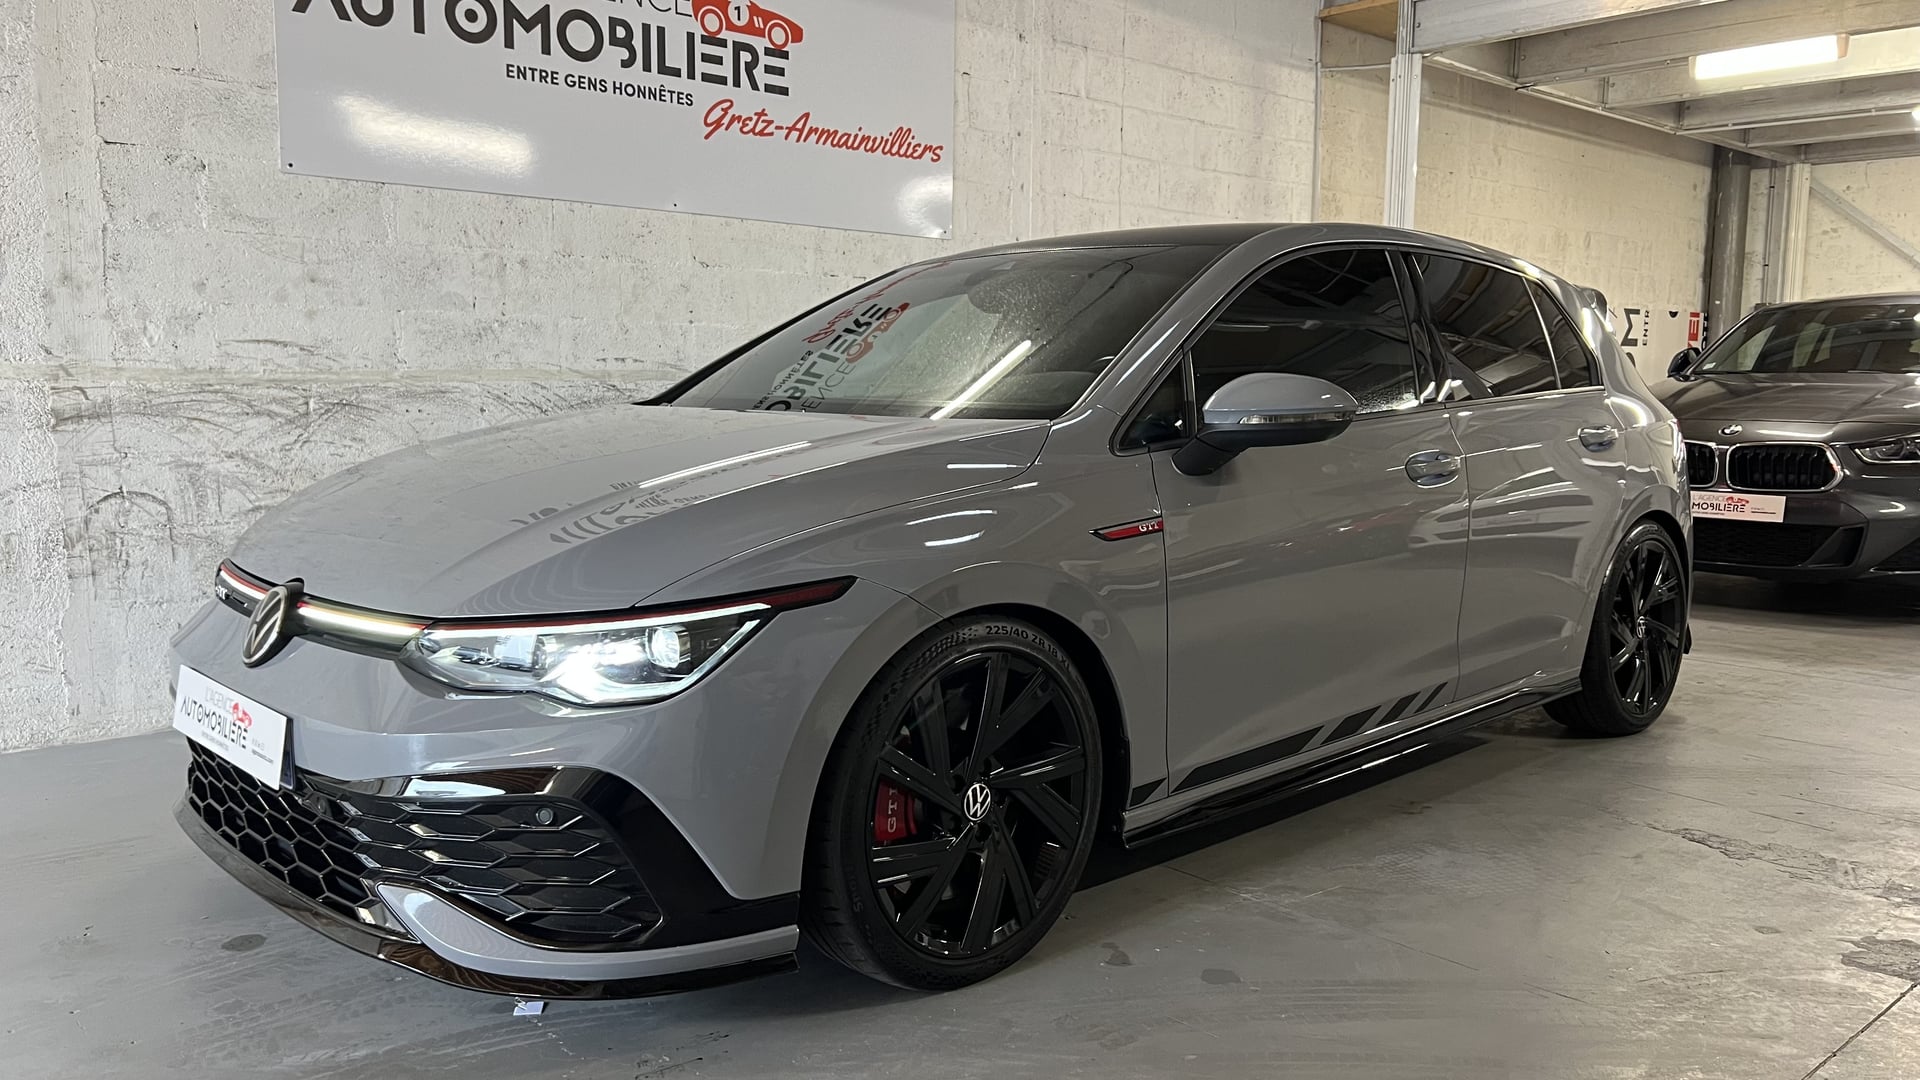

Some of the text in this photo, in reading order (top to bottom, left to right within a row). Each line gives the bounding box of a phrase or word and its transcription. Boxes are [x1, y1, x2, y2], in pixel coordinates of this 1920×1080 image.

[506, 63, 694, 107] ENTRE GENS HONNÊTES
[703, 98, 944, 163] Gretz-Armainvilliers
[1139, 521, 1159, 532] GTI
[985, 625, 1029, 640] 225/40
[887, 787, 898, 833] GTI
